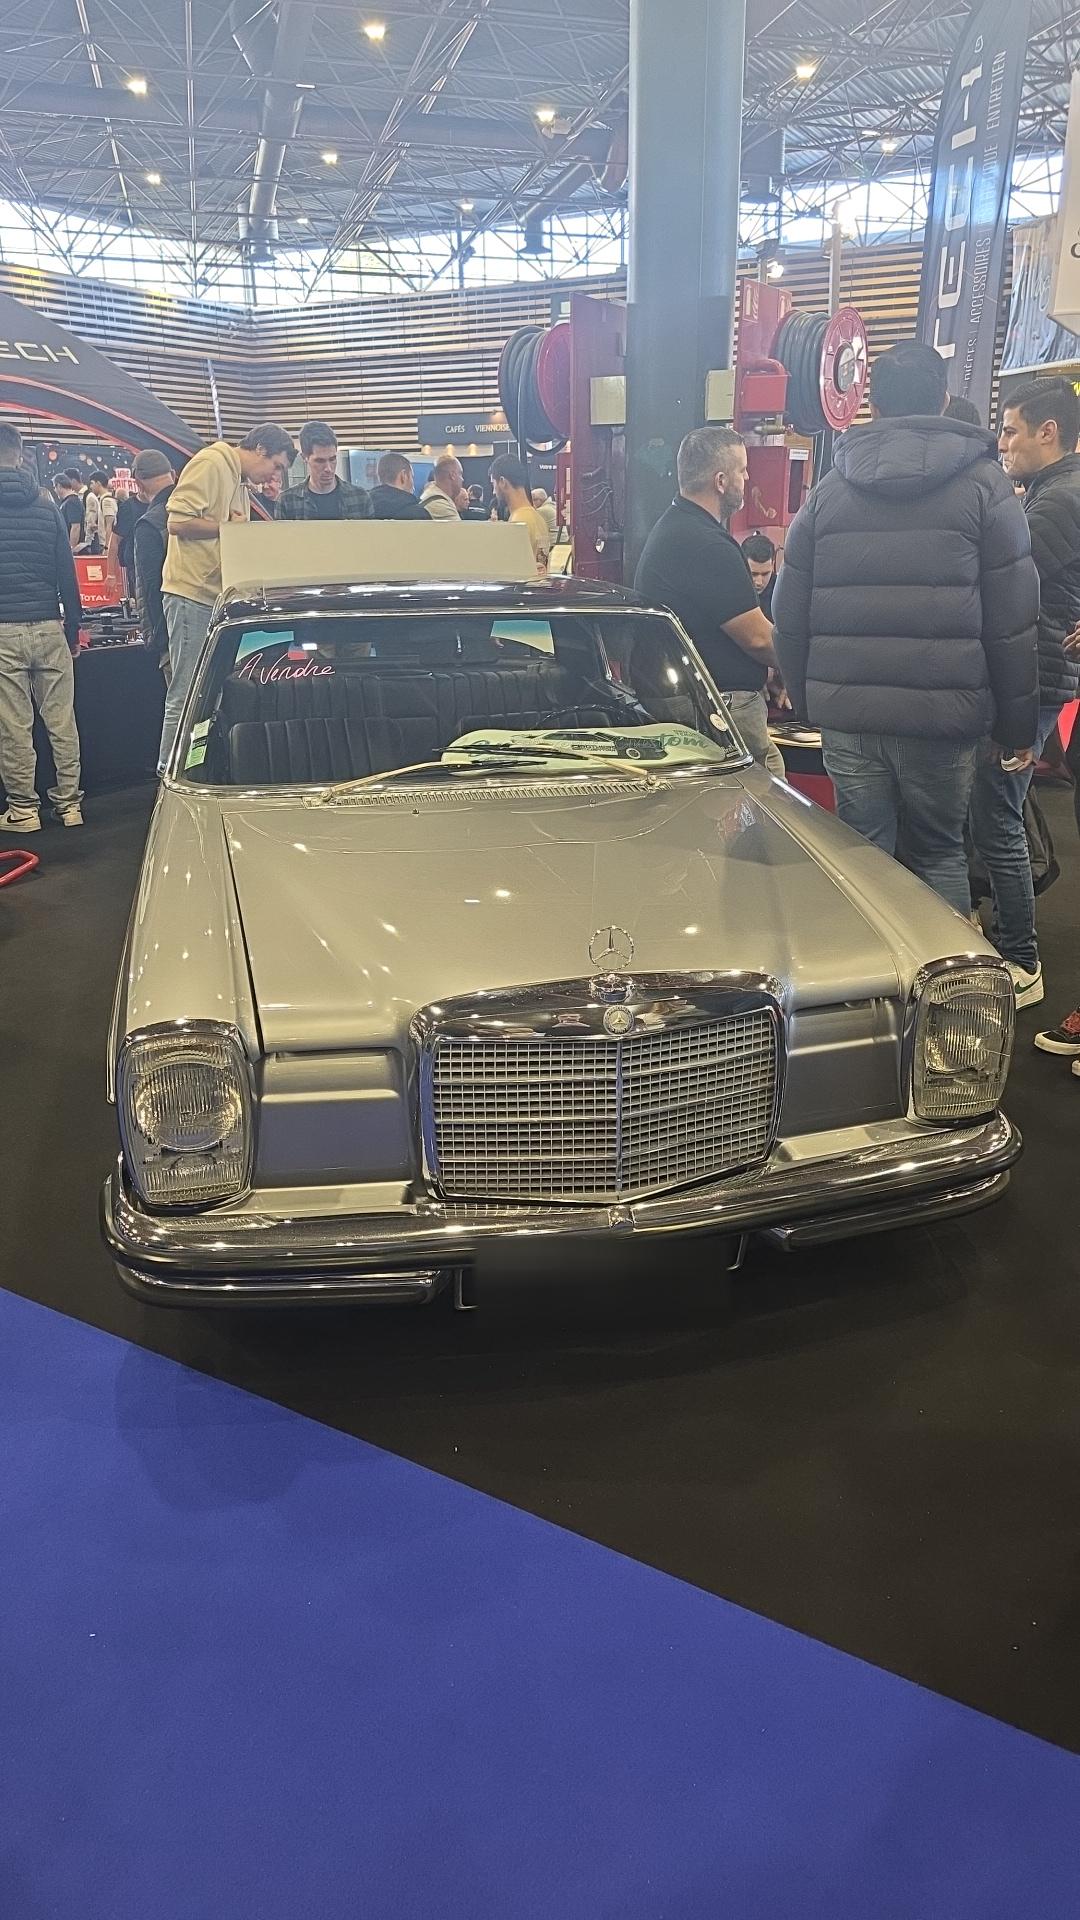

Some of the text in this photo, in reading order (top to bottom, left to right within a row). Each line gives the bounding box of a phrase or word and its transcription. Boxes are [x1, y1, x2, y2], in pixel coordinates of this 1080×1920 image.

[969, 237, 991, 324] ACCESSOIRES
[985, 50, 1007, 131] ENTRETIEN
[445, 424, 465, 433] CAFÉS
[80, 593, 110, 602] TOTAL
